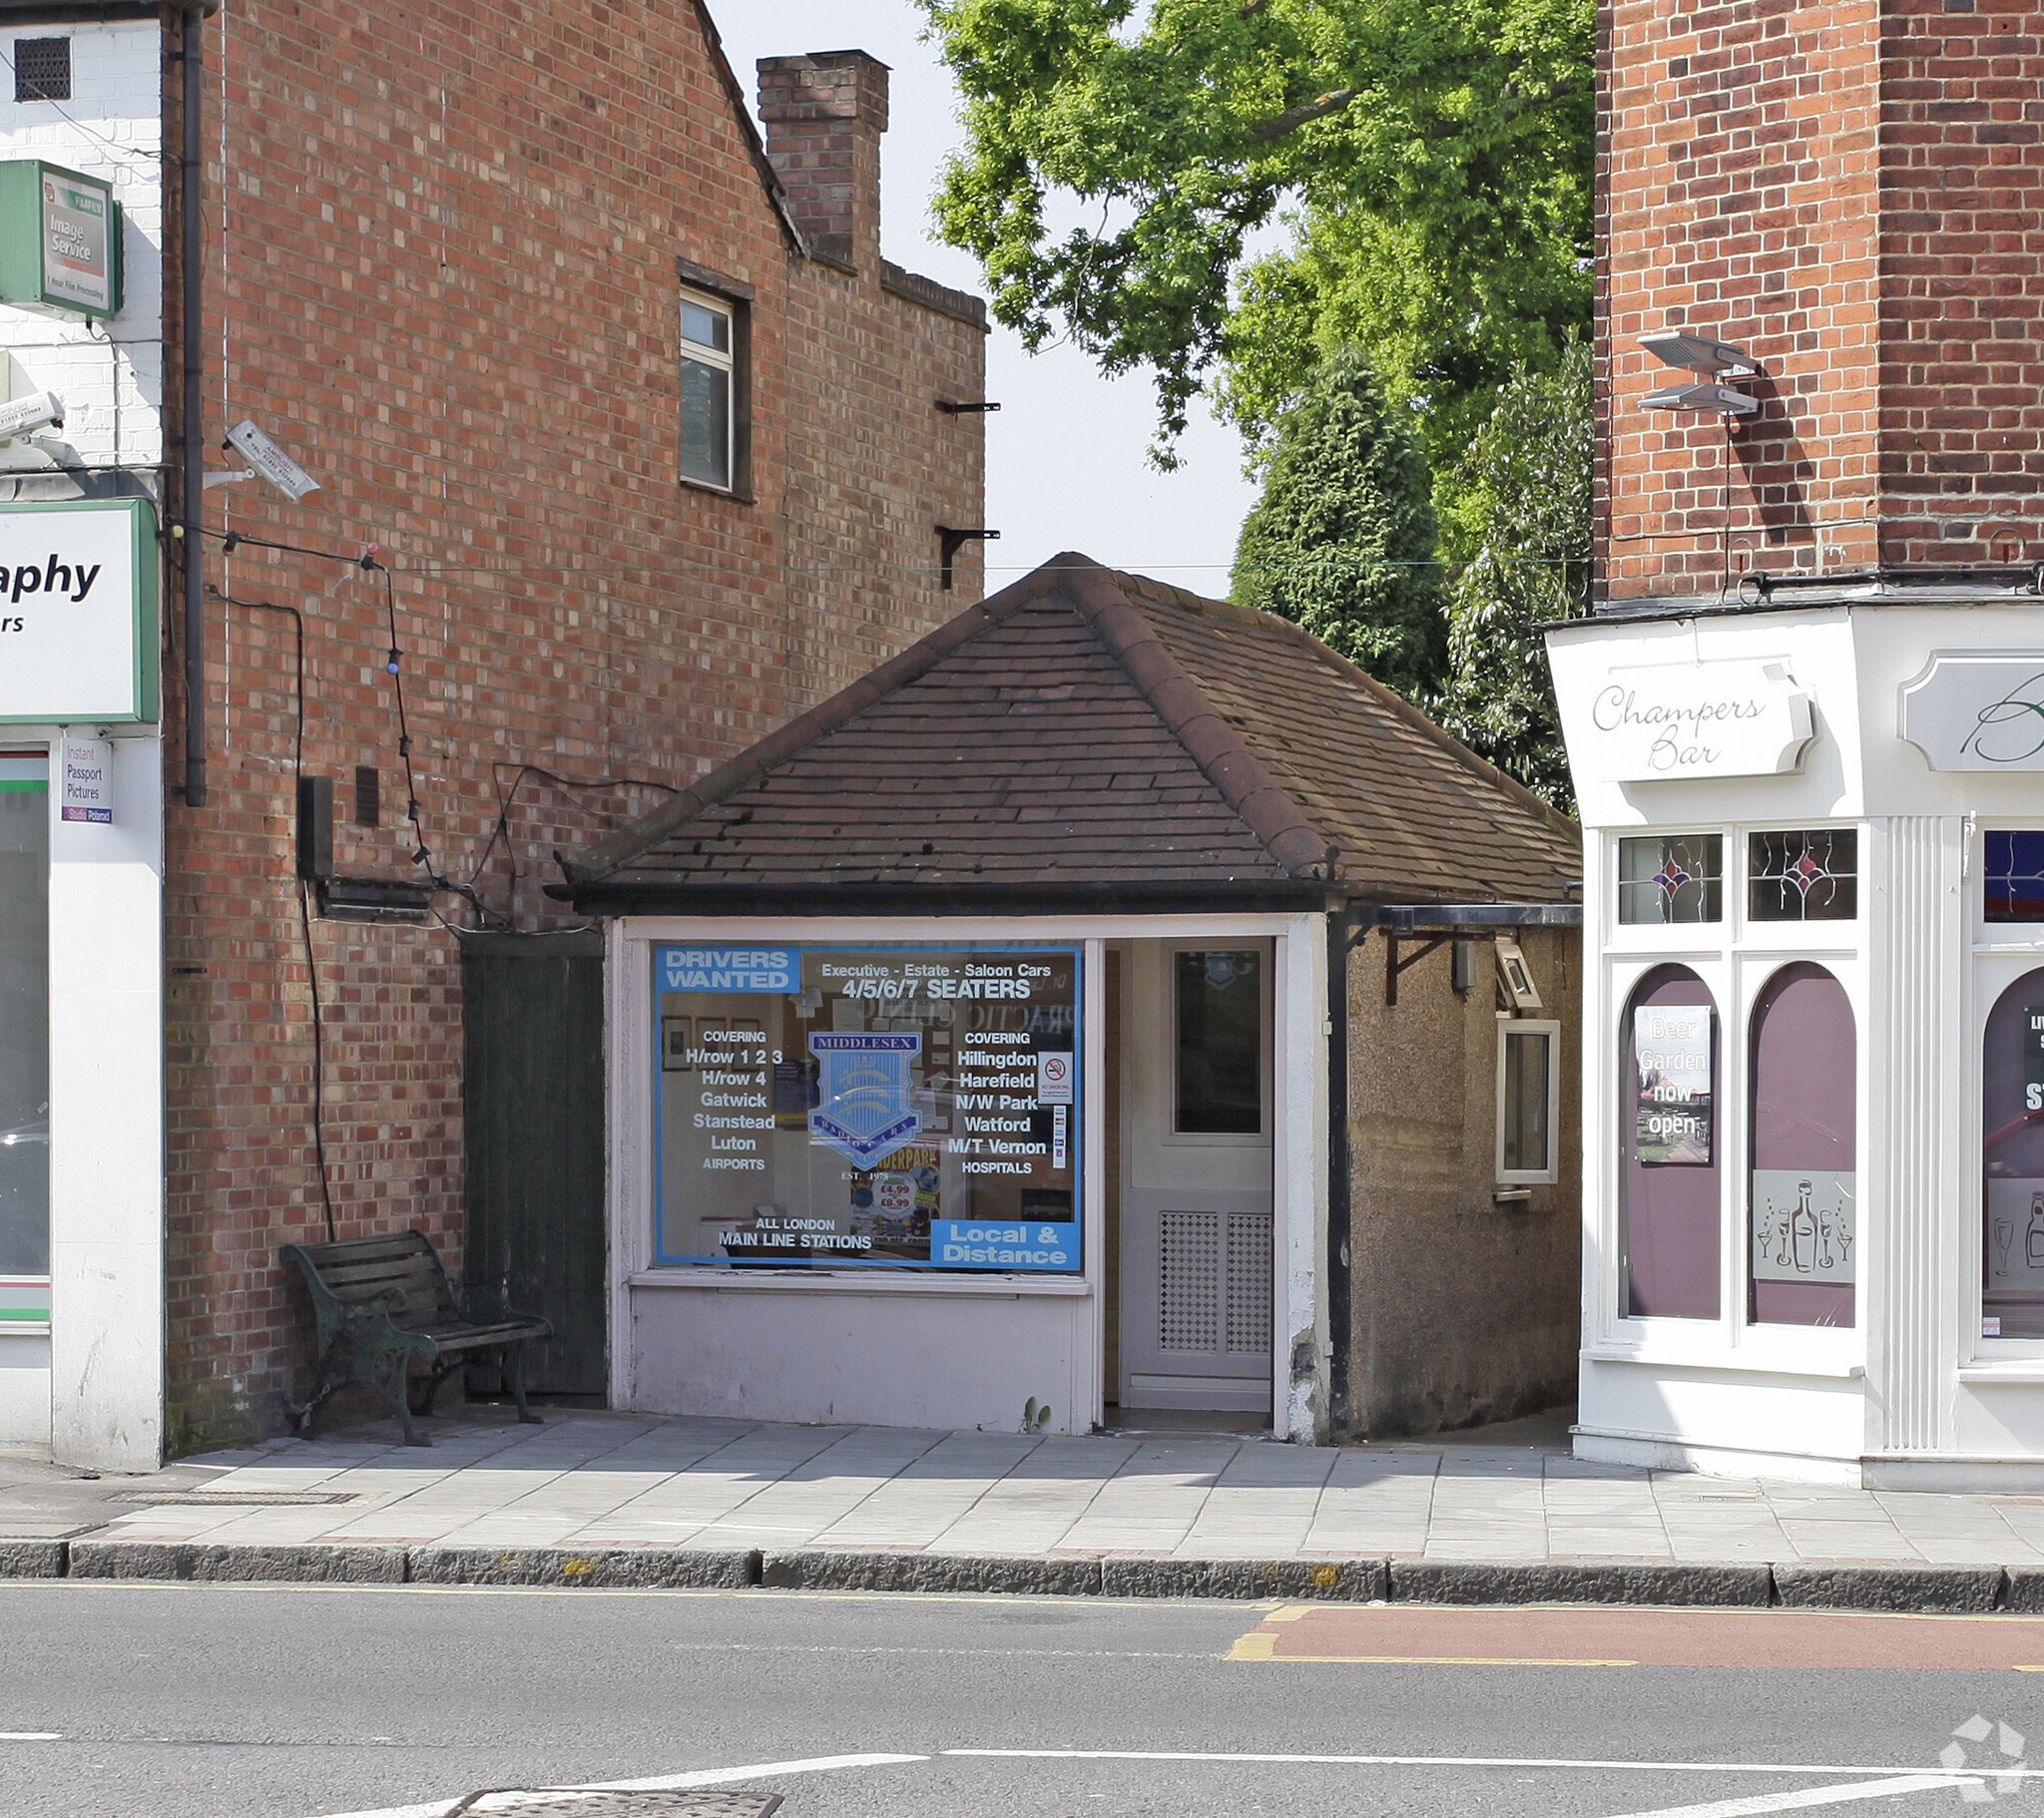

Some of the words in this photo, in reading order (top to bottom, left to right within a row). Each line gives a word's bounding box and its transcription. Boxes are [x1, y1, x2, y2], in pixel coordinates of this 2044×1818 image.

[50, 214, 84, 242] Image
[52, 234, 91, 260] Service
[65, 280, 76, 292] Film
[76, 284, 104, 301] Processing
[1593, 684, 1767, 737] Champers
[67, 744, 95, 761] Instant
[1648, 723, 1722, 770] Bar
[67, 763, 103, 783] Passport
[67, 783, 100, 799] Pictures
[666, 951, 788, 968] DRIVERS
[821, 963, 889, 977] Executive
[904, 964, 949, 977] Estate
[964, 964, 1013, 977] Saloon
[1018, 964, 1051, 977] Cars
[667, 971, 789, 989] WANTED
[842, 979, 918, 999] 4/5/6/7
[926, 979, 1031, 999] SEATERS
[703, 1031, 766, 1043] COVERING
[1652, 1017, 1696, 1040] Beer
[818, 1038, 911, 1049] MIDDLESEX
[965, 1033, 1030, 1044] COVERING
[686, 1048, 735, 1064] H/row
[741, 1050, 749, 1064] 1
[756, 1050, 767, 1065] 2
[771, 1050, 783, 1065] 3
[957, 1051, 1037, 1069] Hillingdon
[1640, 1049, 1707, 1071] Garden
[702, 1070, 750, 1086] H/row
[756, 1071, 766, 1086] 4
[959, 1073, 1034, 1088] Harefield
[701, 1092, 767, 1108] Gatwick
[1654, 1085, 1692, 1103] now
[956, 1095, 994, 1110] N/W
[999, 1095, 1038, 1111] Park
[693, 1113, 775, 1130] Stanstead
[964, 1117, 1031, 1133] Watford
[1649, 1116, 1696, 1138] open
[821, 1121, 860, 1147] RADIO
[711, 1136, 757, 1150] Luton
[948, 1138, 983, 1153] M/T
[988, 1138, 1046, 1154] Vernon
[703, 1158, 766, 1169] AIRPORTS
[962, 1161, 1032, 1174] HOSPITALS
[869, 1171, 889, 1181] 1978
[880, 1184, 909, 1194] £4.99
[756, 1217, 779, 1229] ALL
[783, 1218, 835, 1231] LONDON
[719, 1231, 758, 1246] MAIN
[763, 1233, 794, 1247] LINE
[800, 1234, 872, 1249] STATIONS
[950, 1224, 1027, 1243] Local
[1037, 1226, 1060, 1244] &
[943, 1244, 1068, 1264] Distance
